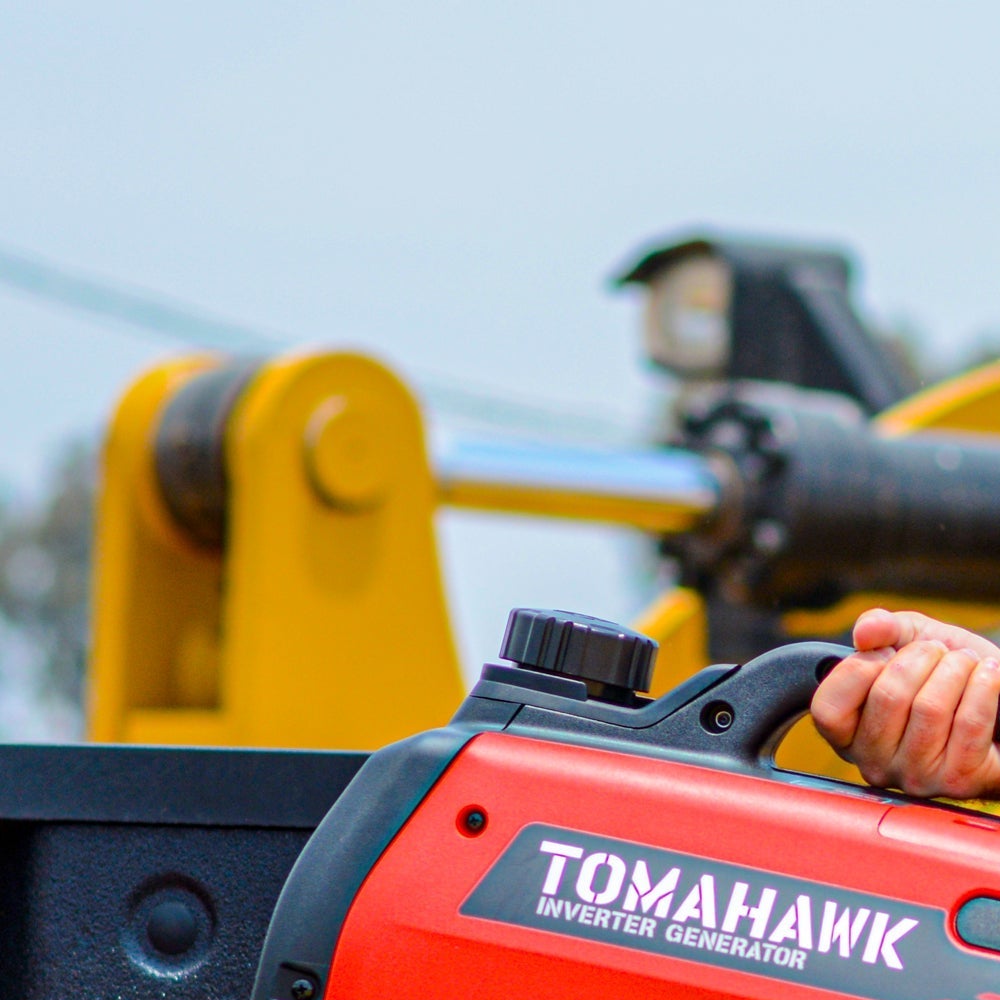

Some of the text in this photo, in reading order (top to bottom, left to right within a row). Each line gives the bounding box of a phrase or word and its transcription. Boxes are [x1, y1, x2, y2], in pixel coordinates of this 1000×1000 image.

[536, 896, 807, 971] INVERTER GENERATOR
[539, 840, 919, 970] TOMAHAWK
